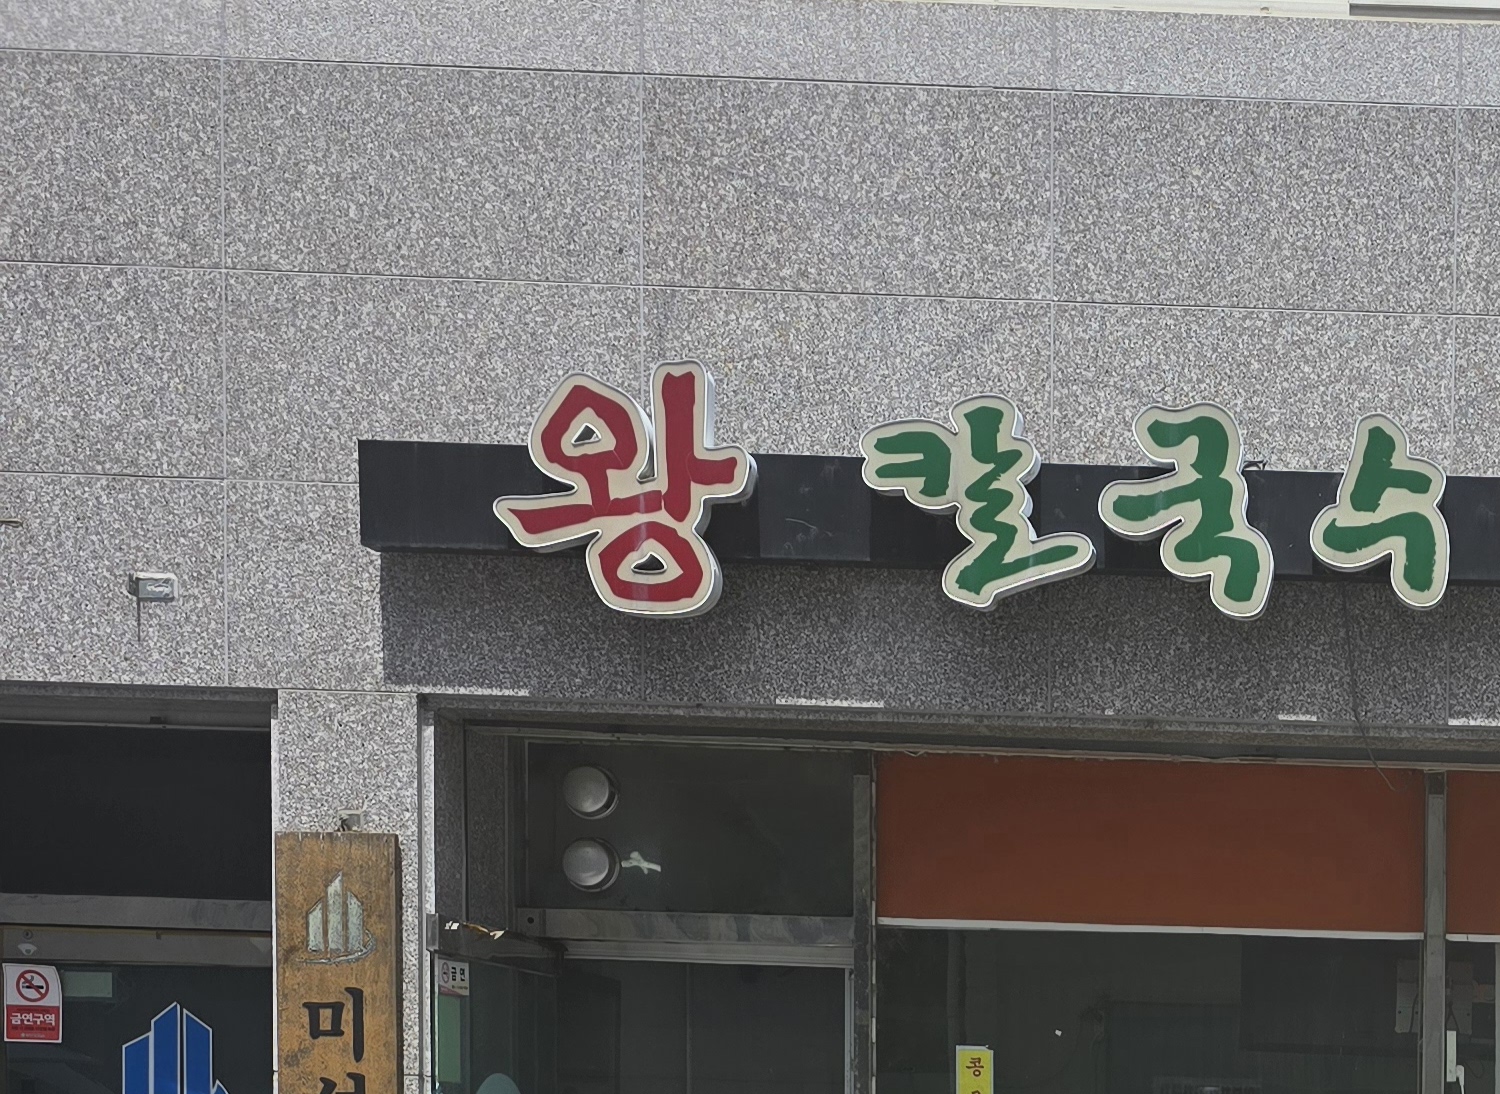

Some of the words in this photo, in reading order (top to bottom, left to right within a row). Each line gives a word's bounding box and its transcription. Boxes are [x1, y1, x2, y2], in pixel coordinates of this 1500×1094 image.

[493, 360, 751, 615] 왕
[860, 393, 1449, 616] 칼국수
[450, 966, 466, 982] 금연
[10, 1012, 56, 1027] 금연구역
